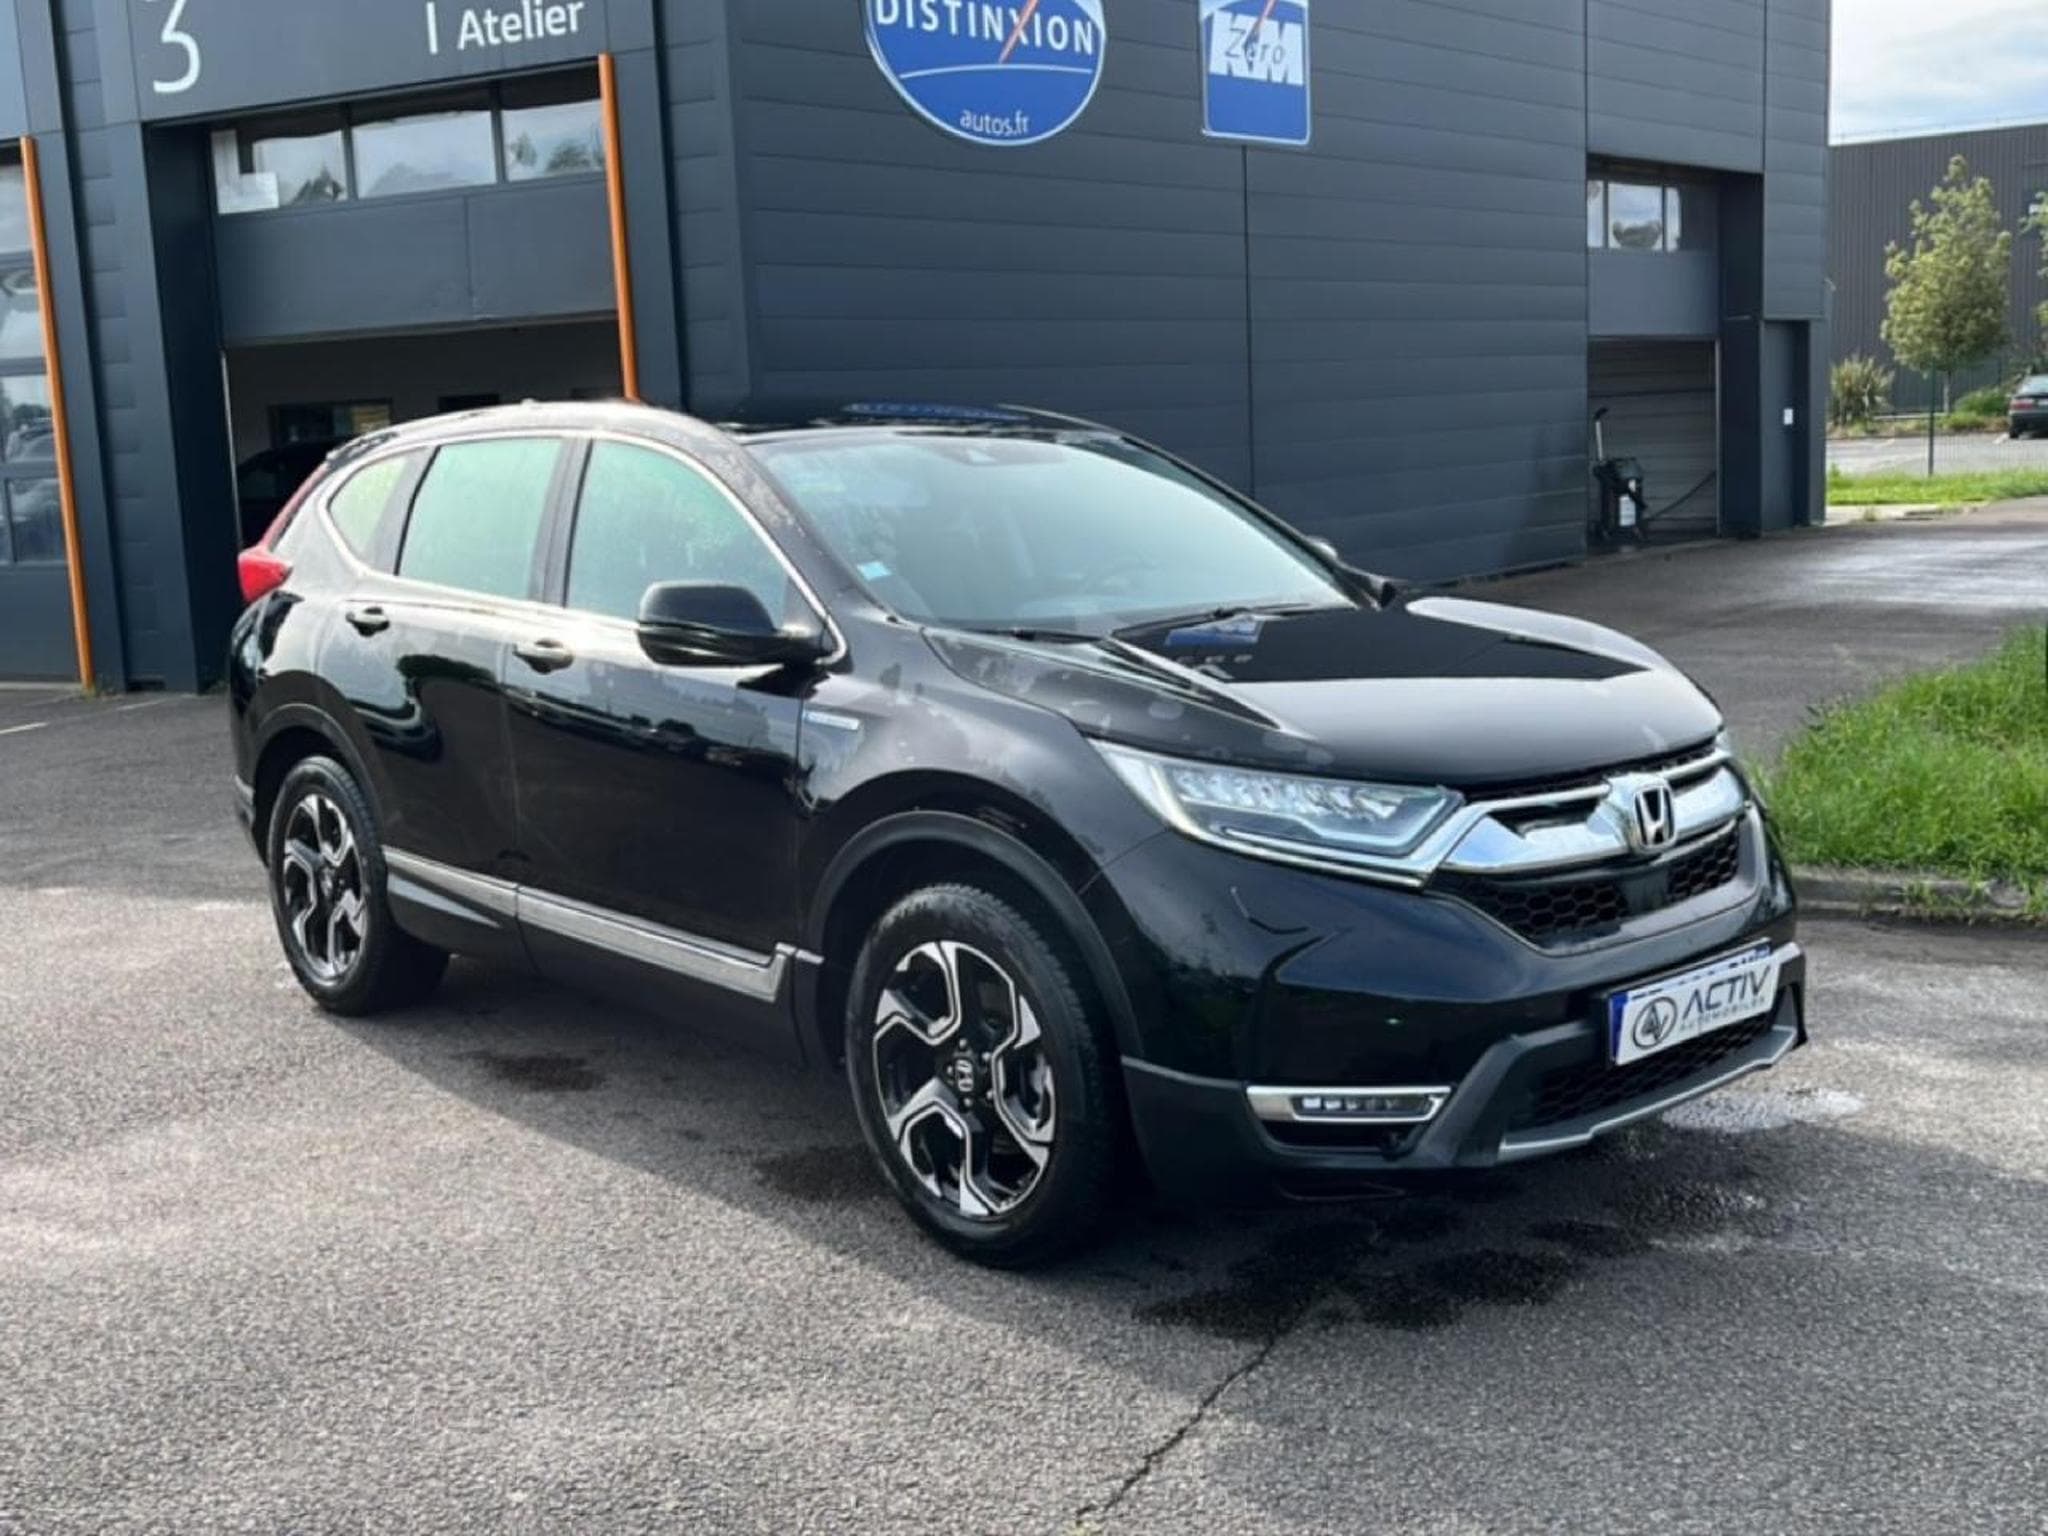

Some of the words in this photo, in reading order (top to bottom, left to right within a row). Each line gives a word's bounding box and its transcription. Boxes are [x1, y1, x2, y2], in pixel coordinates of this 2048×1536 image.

[146, 0, 200, 93] 3
[457, 0, 584, 50] Atelier
[875, 0, 1093, 56] DISTINXION
[960, 108, 1030, 136] autos.fr
[1682, 964, 1771, 1021] ACTIV
